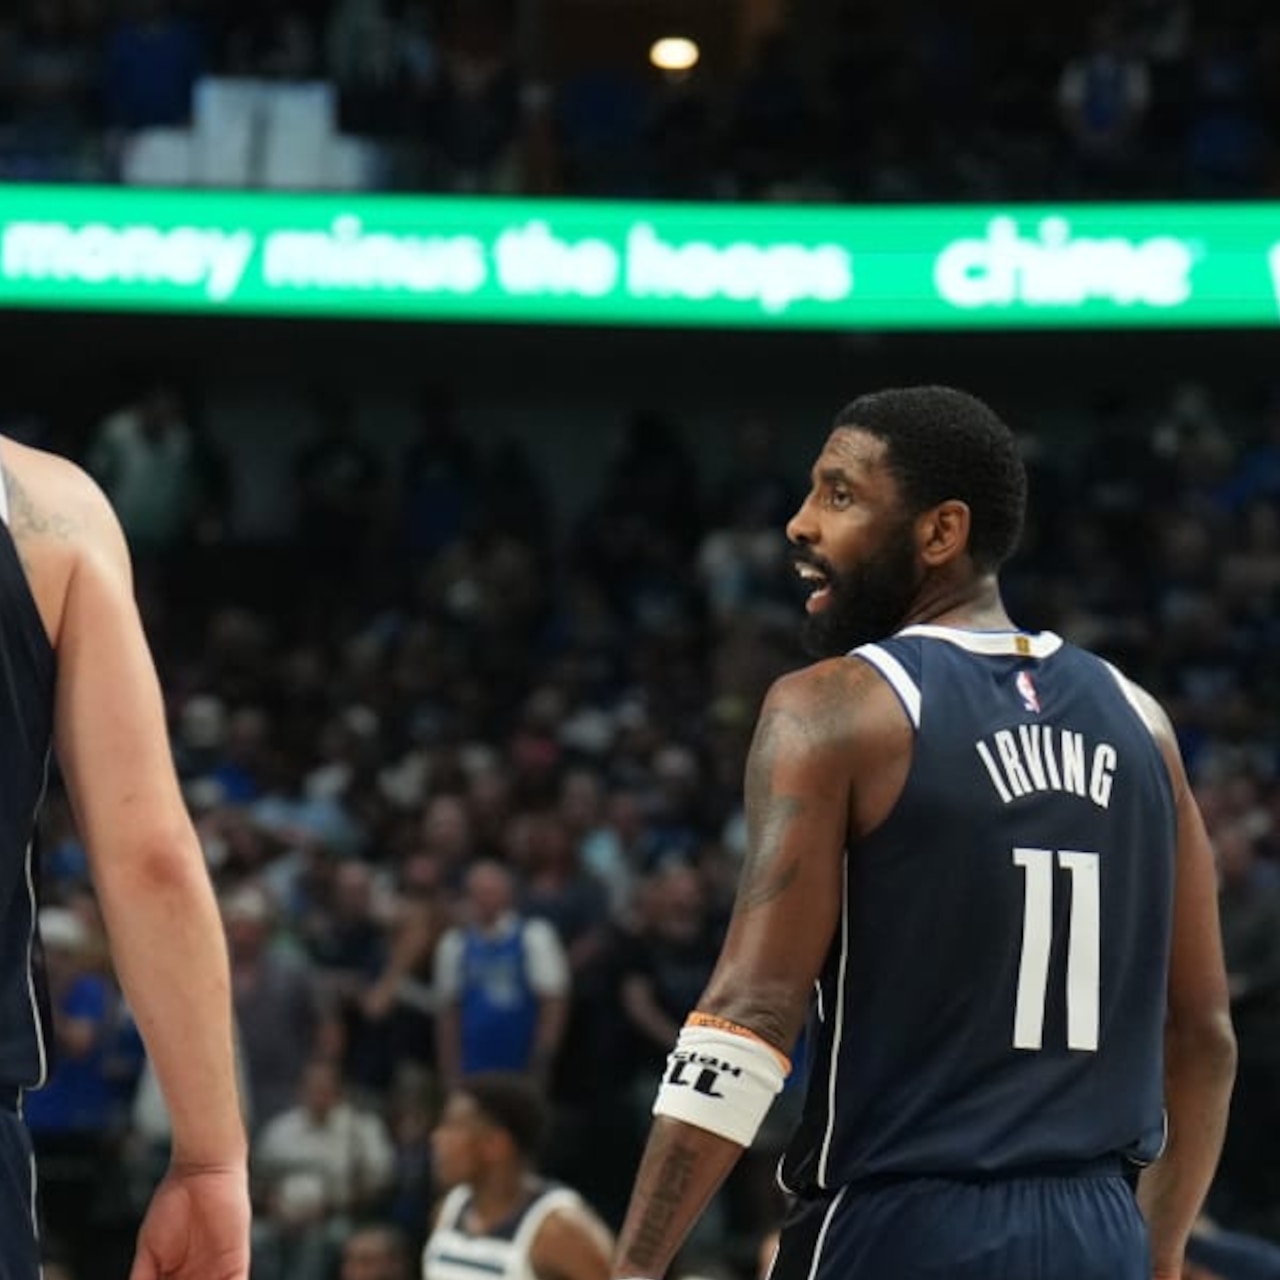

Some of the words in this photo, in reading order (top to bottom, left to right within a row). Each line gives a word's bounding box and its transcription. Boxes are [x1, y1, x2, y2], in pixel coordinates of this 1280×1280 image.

[2, 222, 252, 299] money
[265, 216, 486, 292] minus
[495, 222, 618, 296] the
[627, 225, 852, 310] hoops
[935, 217, 1193, 307] chime
[976, 723, 1118, 809] IRVING
[1012, 847, 1100, 1051] 11
